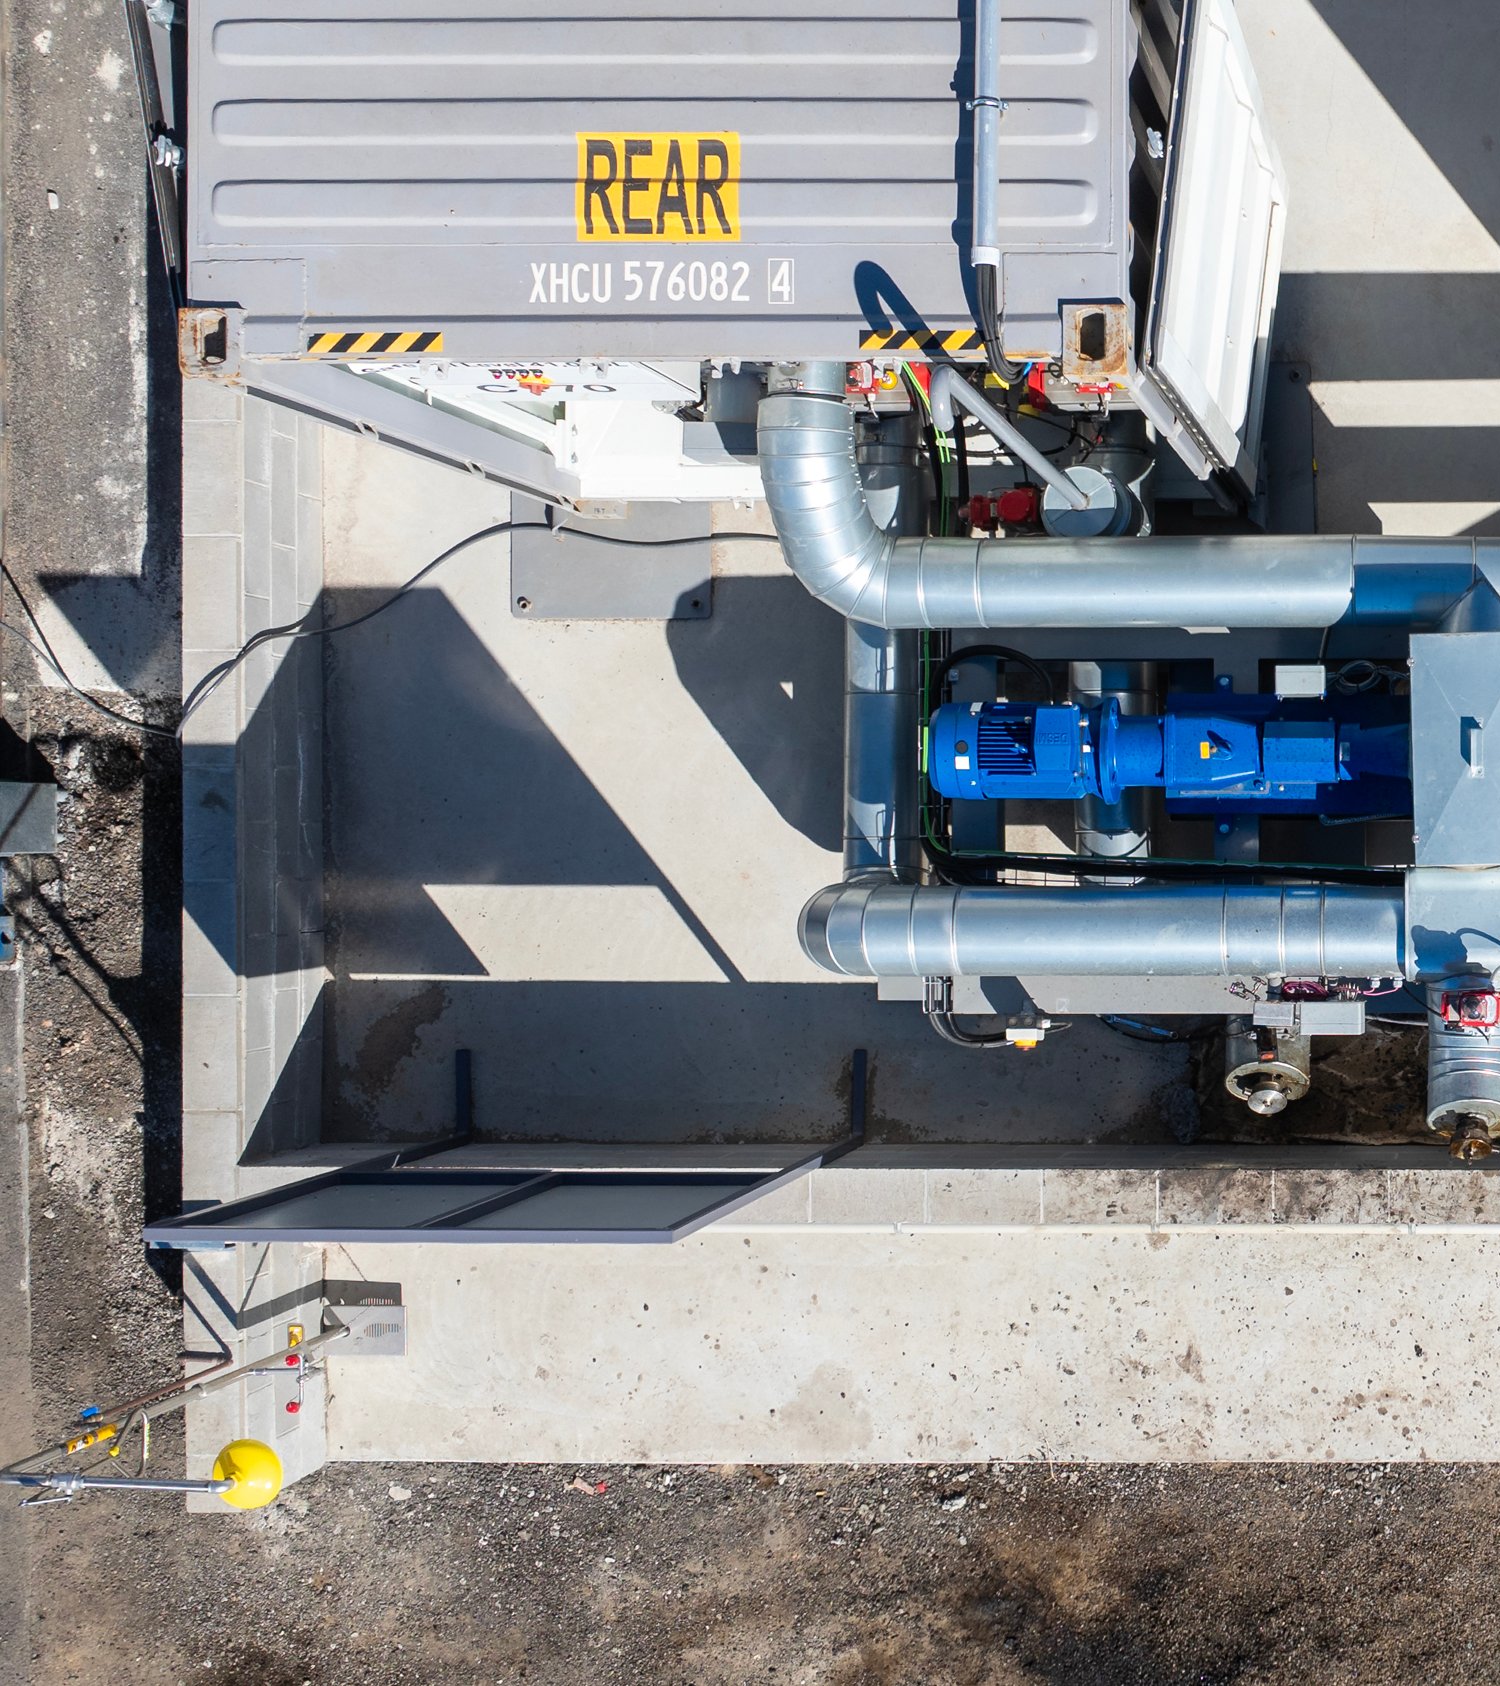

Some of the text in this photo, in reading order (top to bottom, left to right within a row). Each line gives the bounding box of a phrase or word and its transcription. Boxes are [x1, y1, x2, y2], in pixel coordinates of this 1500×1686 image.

[584, 139, 732, 234] REAR
[529, 260, 792, 303] XHCU 576082 4
[476, 384, 617, 393] C70
